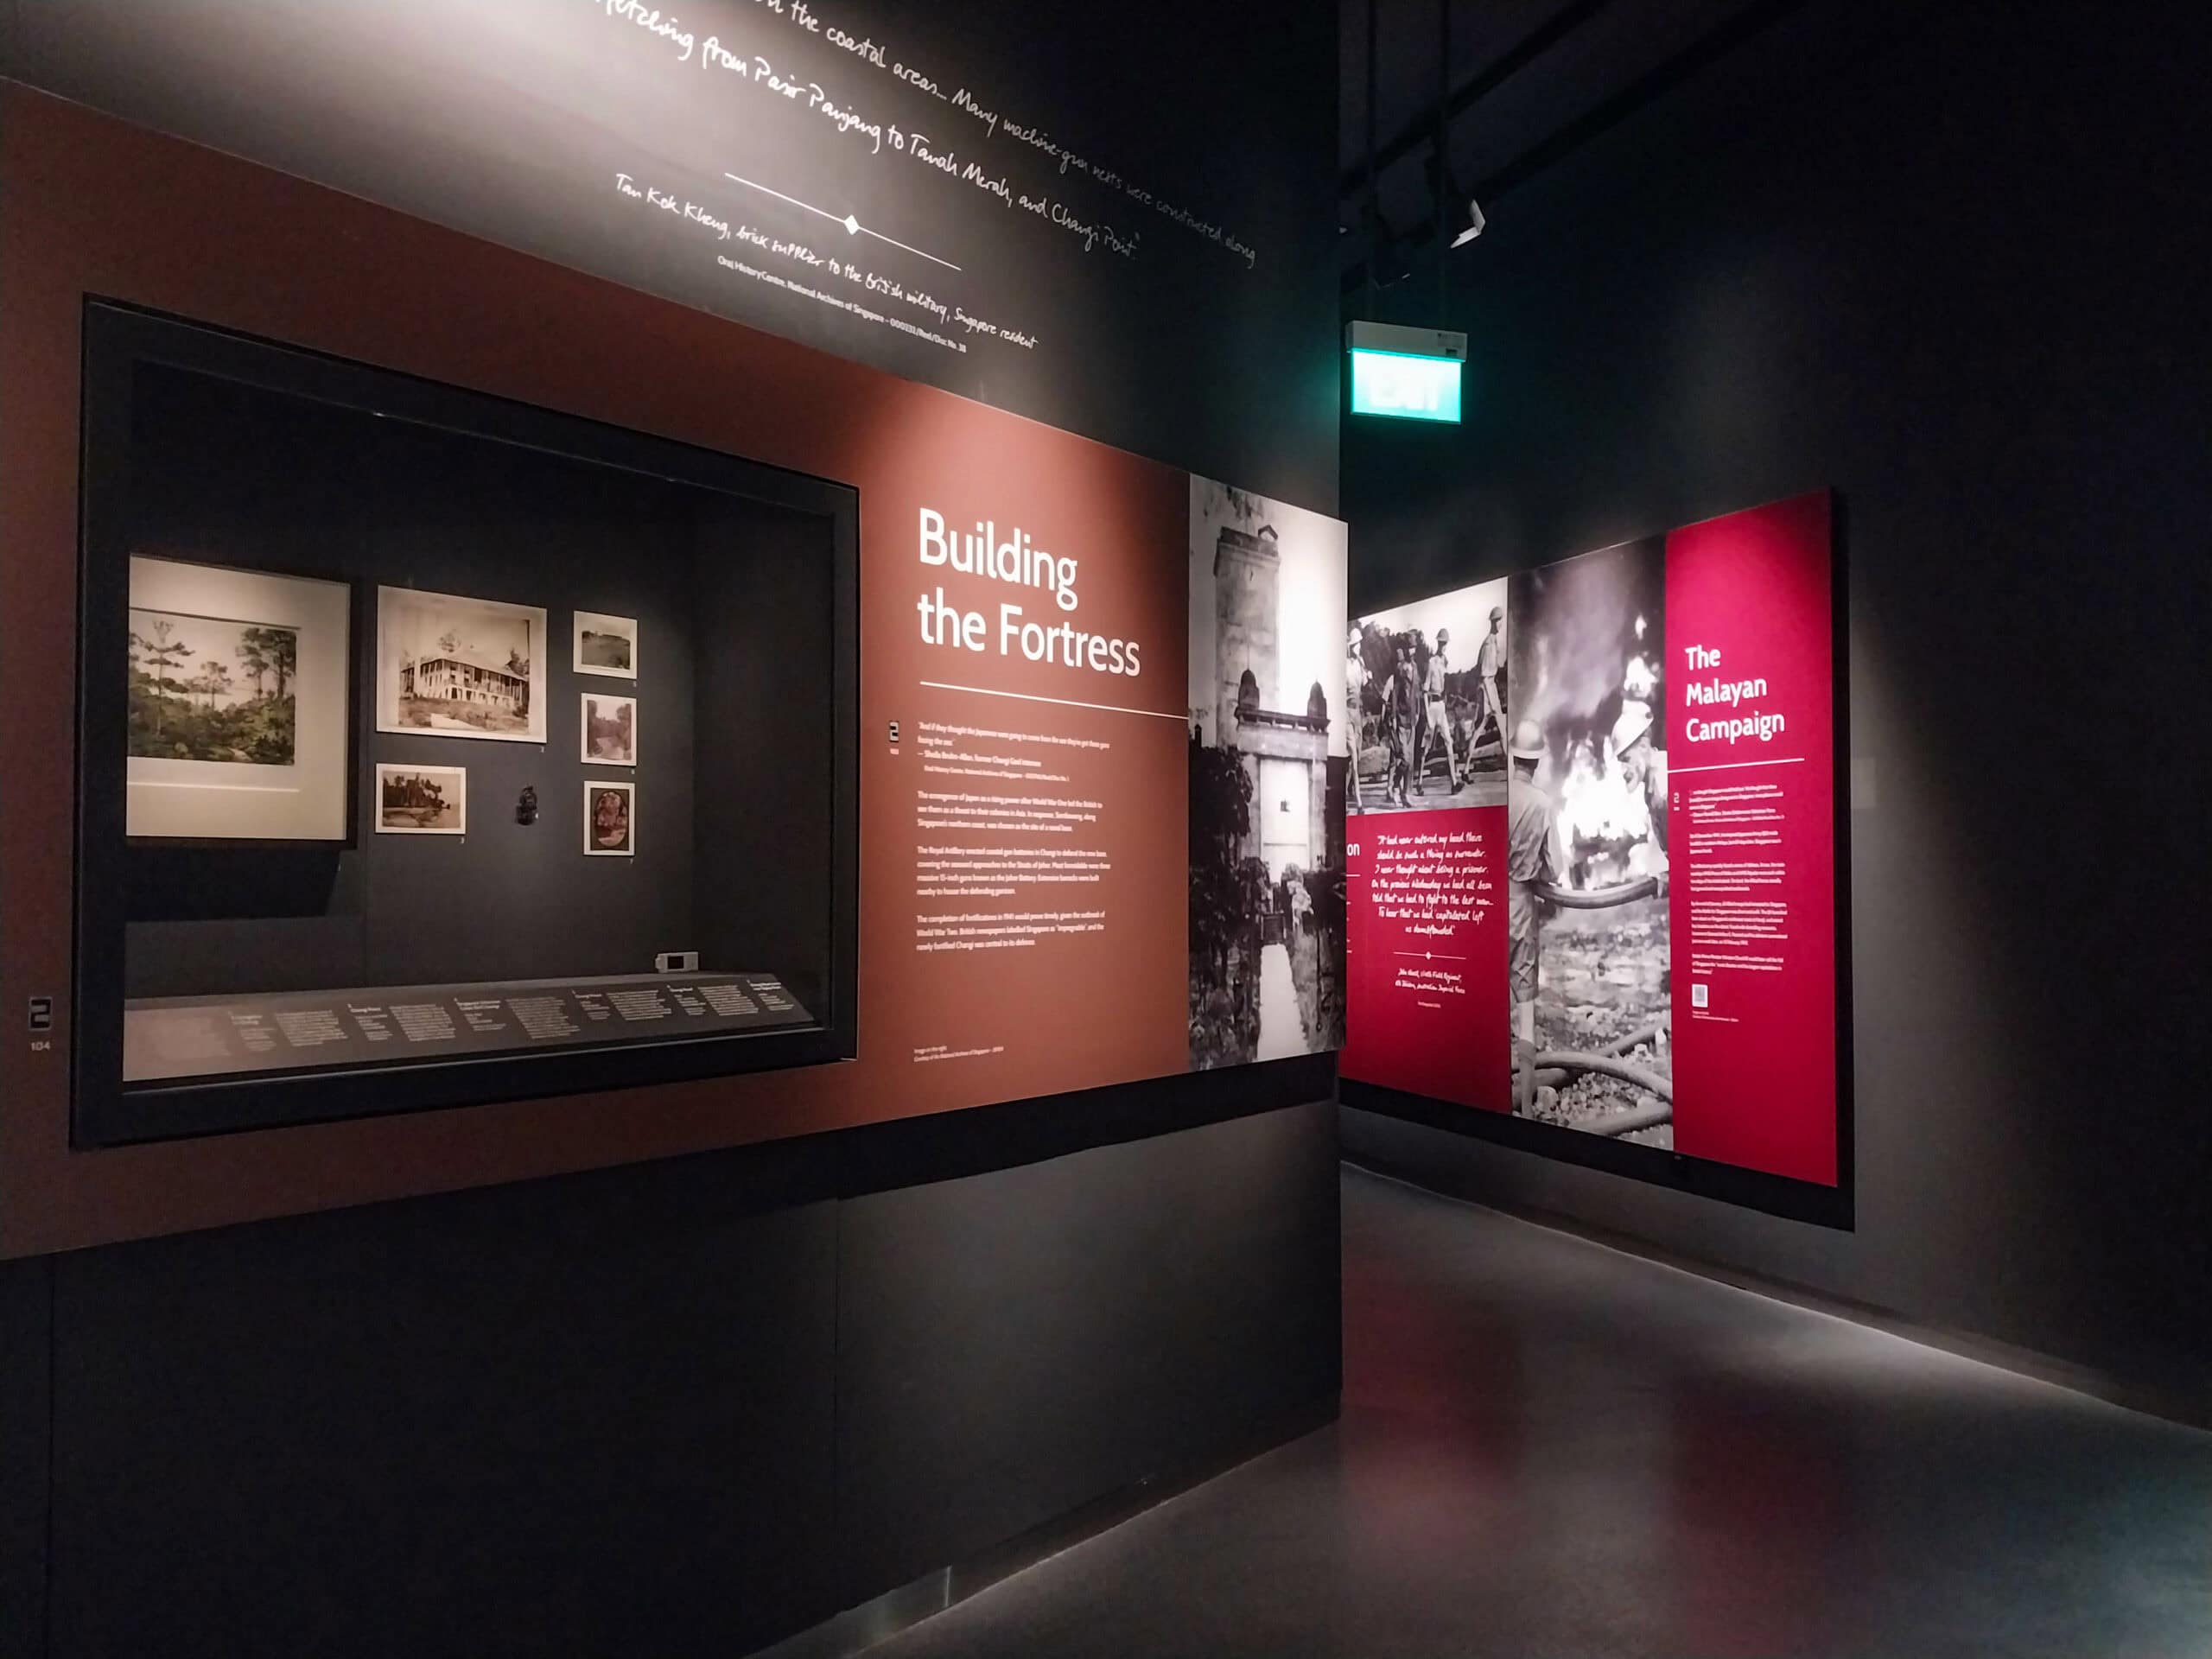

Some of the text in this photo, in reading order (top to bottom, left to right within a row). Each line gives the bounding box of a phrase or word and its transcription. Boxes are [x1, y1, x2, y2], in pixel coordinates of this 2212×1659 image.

[702, 36, 747, 77] from
[754, 56, 807, 99] Pasir
[809, 83, 881, 155] Panjang
[887, 124, 905, 150] to
[910, 133, 958, 176] Tanah
[1018, 195, 1049, 219] and
[1052, 203, 1100, 252] Changi
[791, 0, 820, 32] the
[827, 28, 887, 68] coastal
[951, 88, 998, 138] Many
[1225, 237, 1255, 270] along
[616, 173, 642, 199] Tan
[646, 187, 681, 214] Kok
[828, 257, 841, 275] to
[843, 262, 863, 283] the
[918, 506, 1078, 612] Building
[917, 586, 1141, 677] the Fortress
[1685, 644, 1721, 671] The
[1686, 677, 1768, 708] Malayan
[1686, 710, 1785, 745] Campaign
